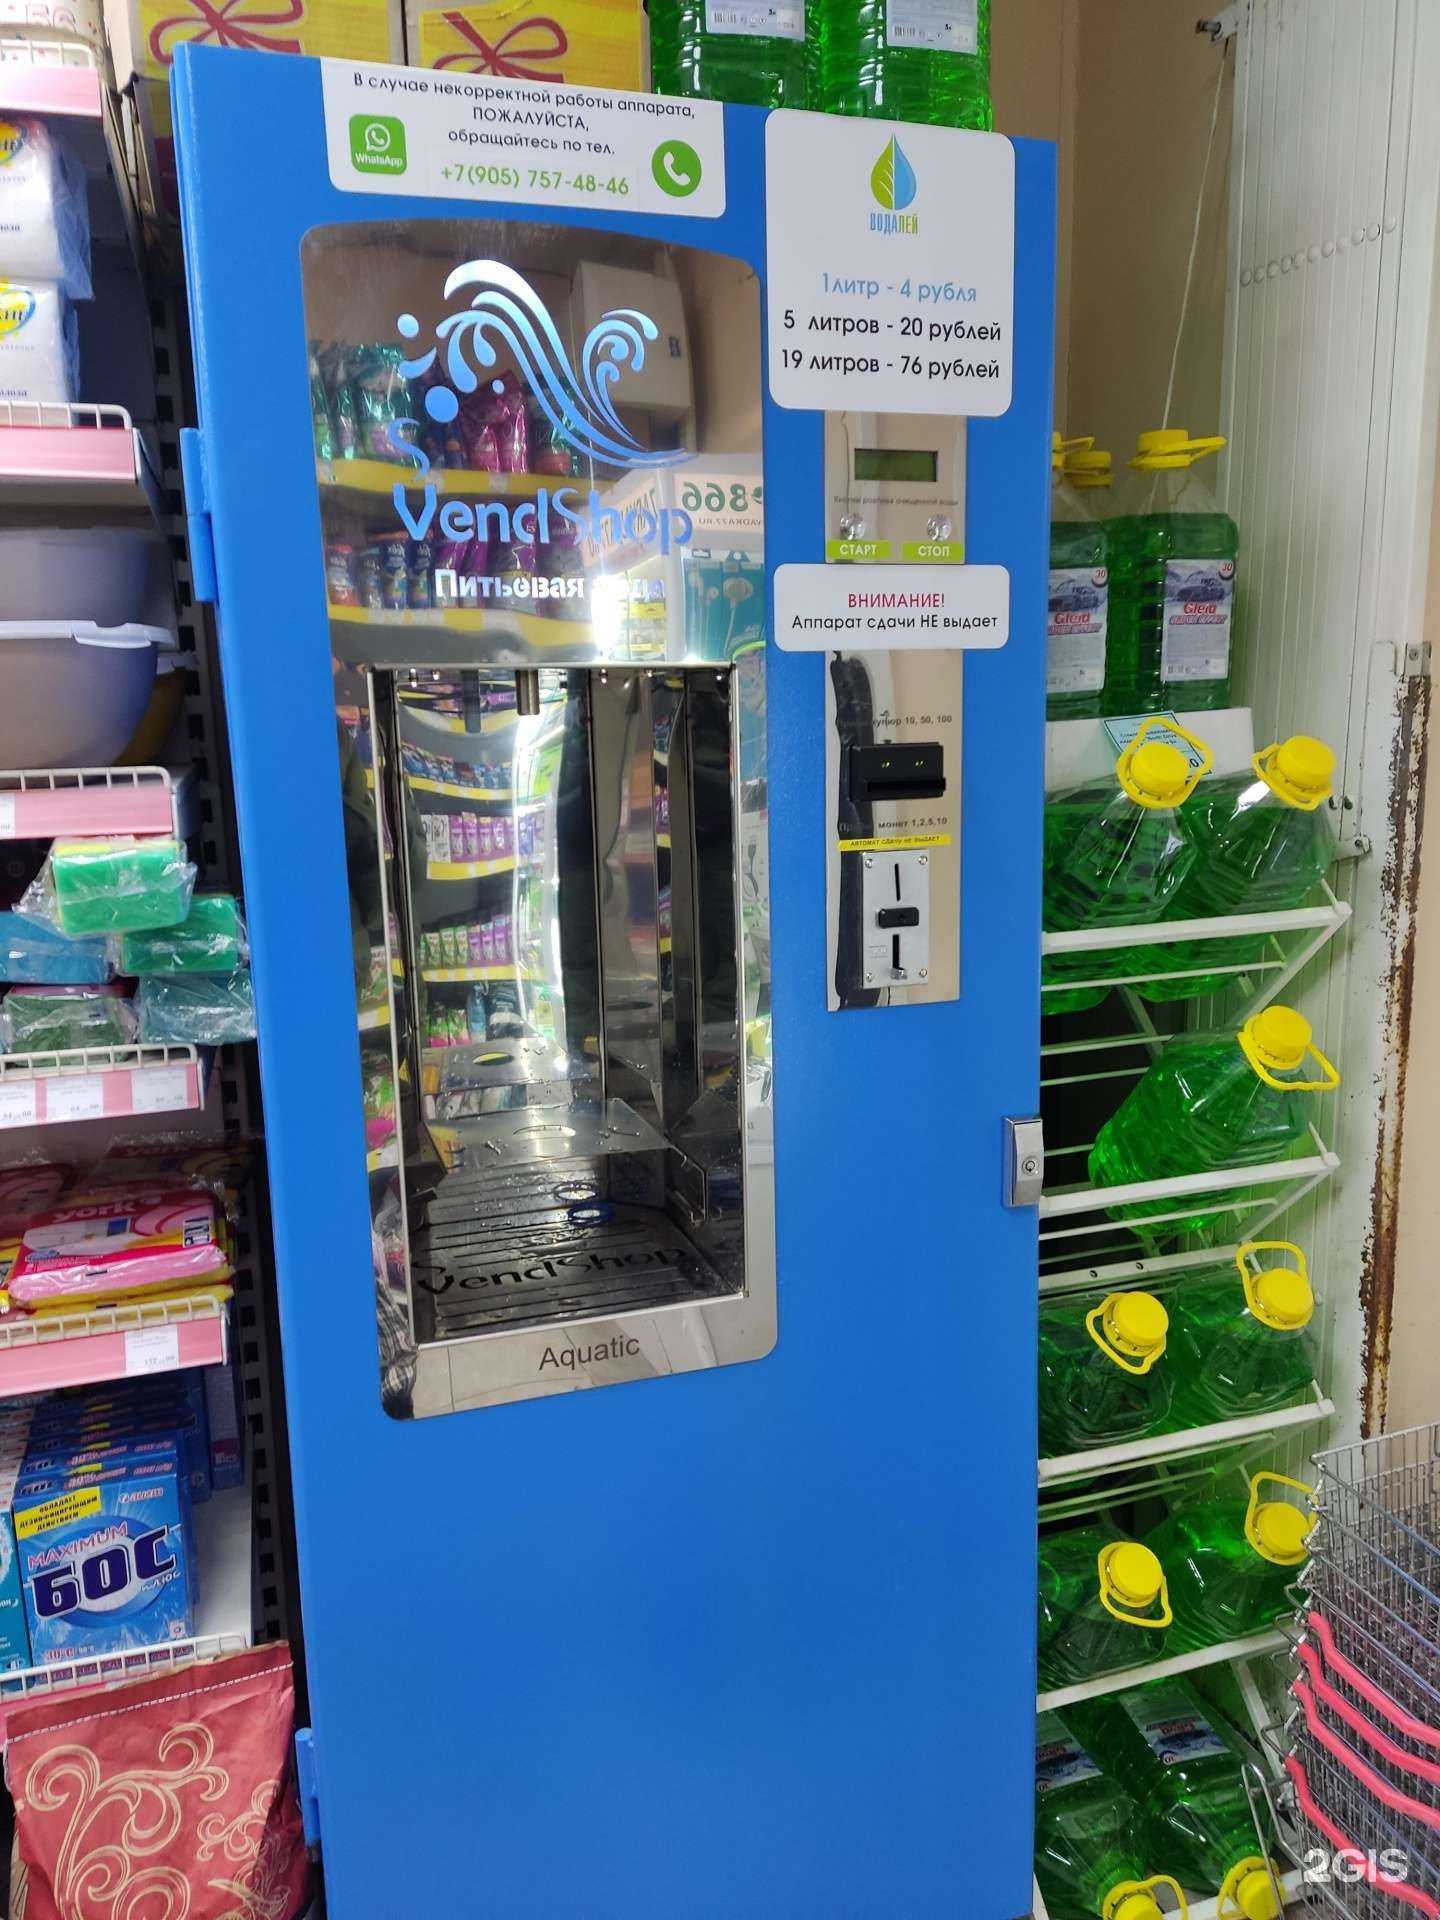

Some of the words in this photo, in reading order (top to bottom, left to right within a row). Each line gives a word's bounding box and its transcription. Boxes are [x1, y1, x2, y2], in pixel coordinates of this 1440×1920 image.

[354, 73, 364, 86] В
[368, 75, 429, 94] случае
[434, 80, 551, 105] некорректной
[555, 93, 613, 111] работы
[617, 98, 696, 118] аппарата,
[472, 105, 590, 131] ПОЖАЛУЙСТА,
[448, 129, 558, 151] обращайтесь
[562, 138, 582, 153] по
[586, 141, 615, 155] тел.
[355, 152, 403, 168] WhatsApp
[441, 164, 520, 189] +7(905)
[528, 169, 630, 196] 757-48-46
[822, 272, 880, 299] 1литр
[900, 279, 911, 297] 4
[918, 283, 977, 305] рубля
[783, 310, 795, 329] 5
[808, 314, 880, 337] литров
[900, 317, 923, 337] 20
[929, 320, 1001, 342] рублей
[782, 349, 802, 369] 19
[809, 355, 880, 376] литров
[900, 356, 922, 375] 76
[928, 357, 1000, 379] рублей
[839, 544, 876, 555] СТАРТ
[918, 545, 949, 557] СТОП
[435, 568, 585, 600] Питьевая
[848, 593, 945, 608] ВНИМАНИЕ!
[792, 615, 862, 632] Аппарат
[867, 617, 915, 631] сдачи
[920, 615, 938, 628] НЕ
[943, 616, 998, 630] выдает
[936, 714, 953, 724] 100
[878, 821, 908, 829] монет
[850, 839, 880, 847] АВТОМАТ
[539, 1335, 641, 1371] Aquatic
[28, 1520, 129, 1570] MAXIMUM
[31, 1524, 177, 1620] БОС
